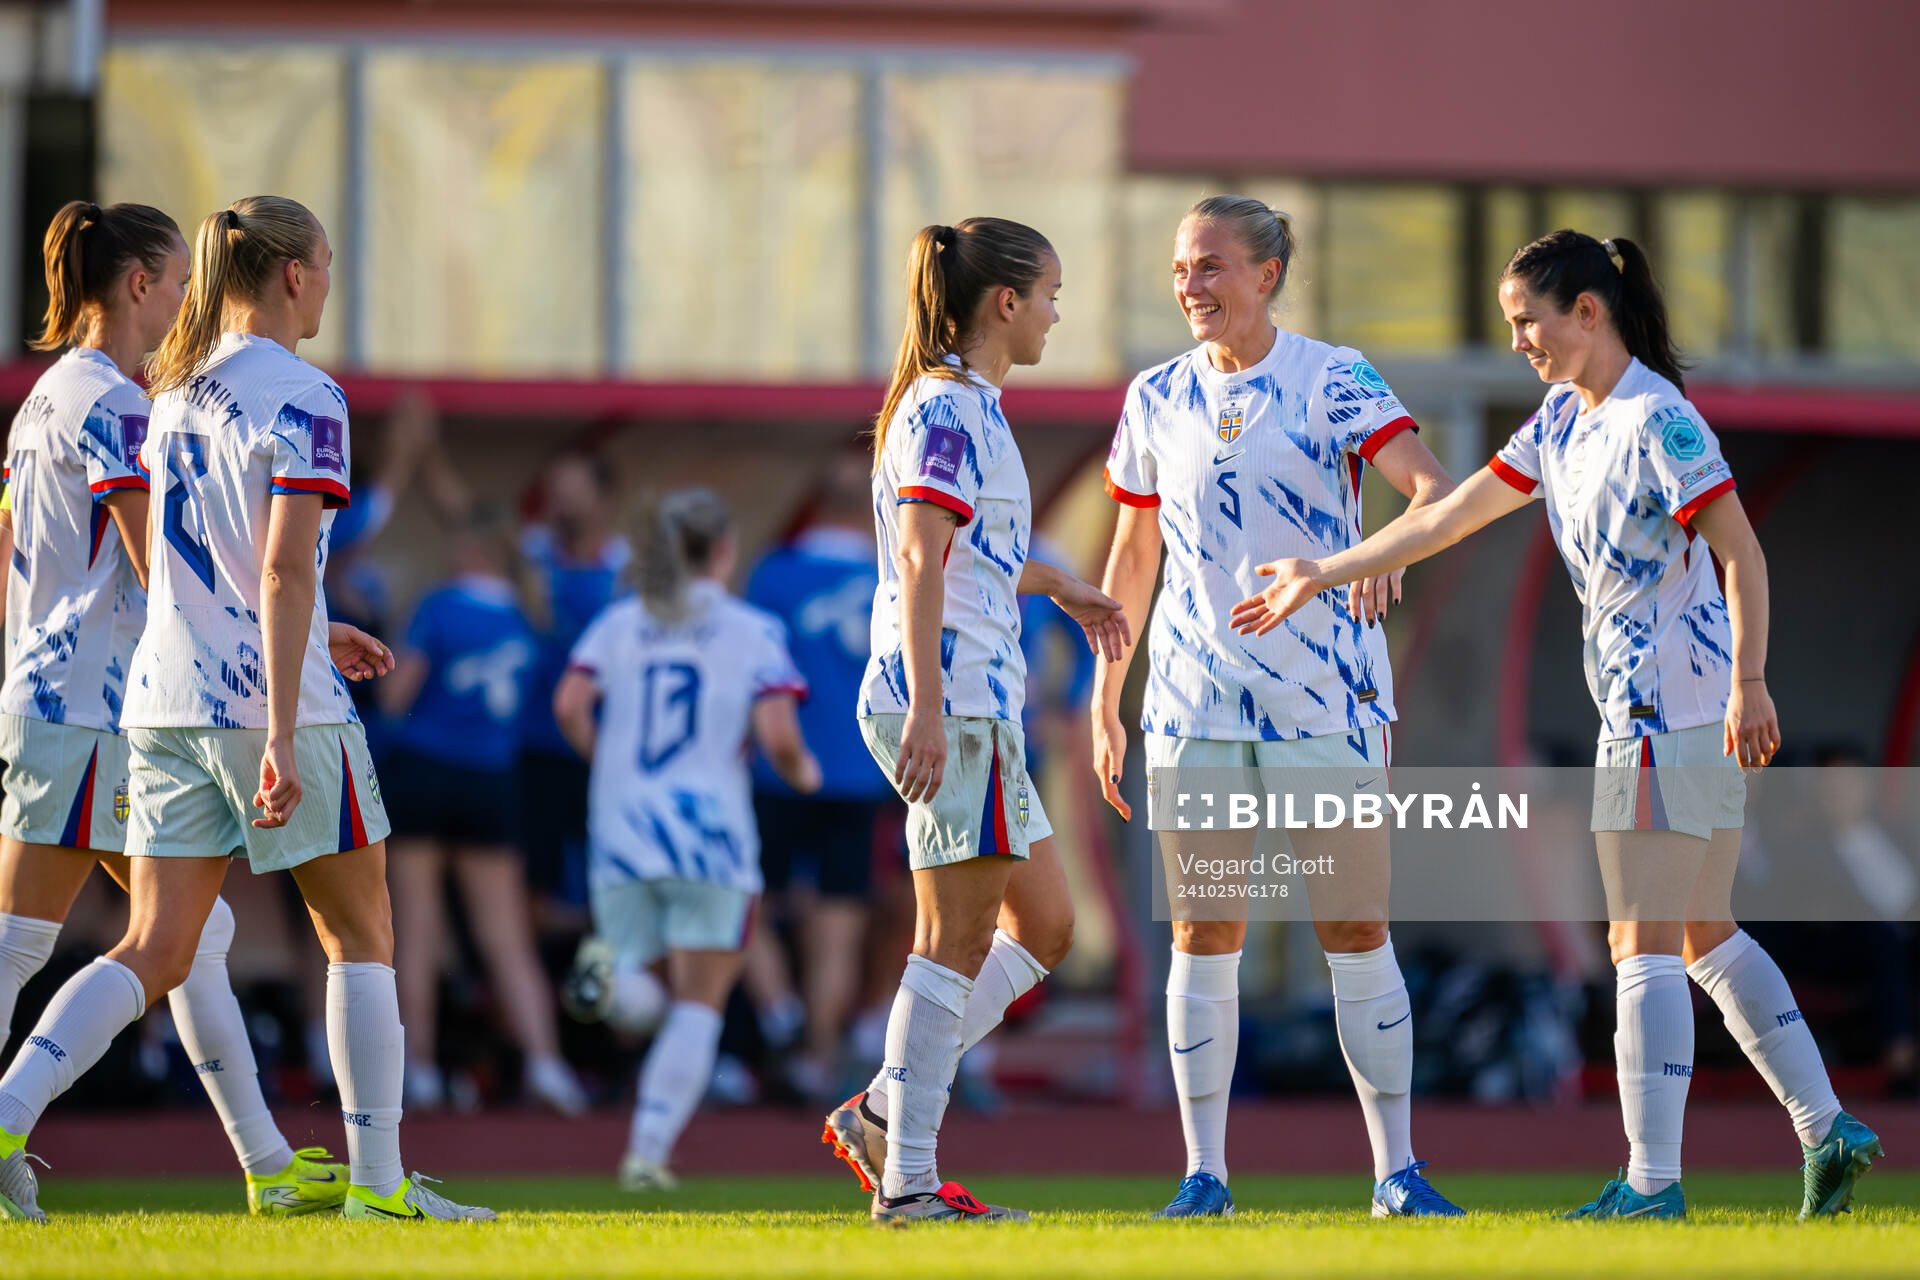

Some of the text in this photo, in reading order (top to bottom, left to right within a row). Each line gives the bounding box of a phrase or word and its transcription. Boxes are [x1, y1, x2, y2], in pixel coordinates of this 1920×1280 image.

[1216, 471, 1243, 530] 5
[161, 431, 215, 594] 8
[1776, 1009, 1803, 1027] NOR
[26, 1035, 67, 1062] NORGE
[887, 1066, 907, 1082] RGE
[1664, 1062, 1693, 1078] NORG
[343, 1111, 371, 1126] ORGE
